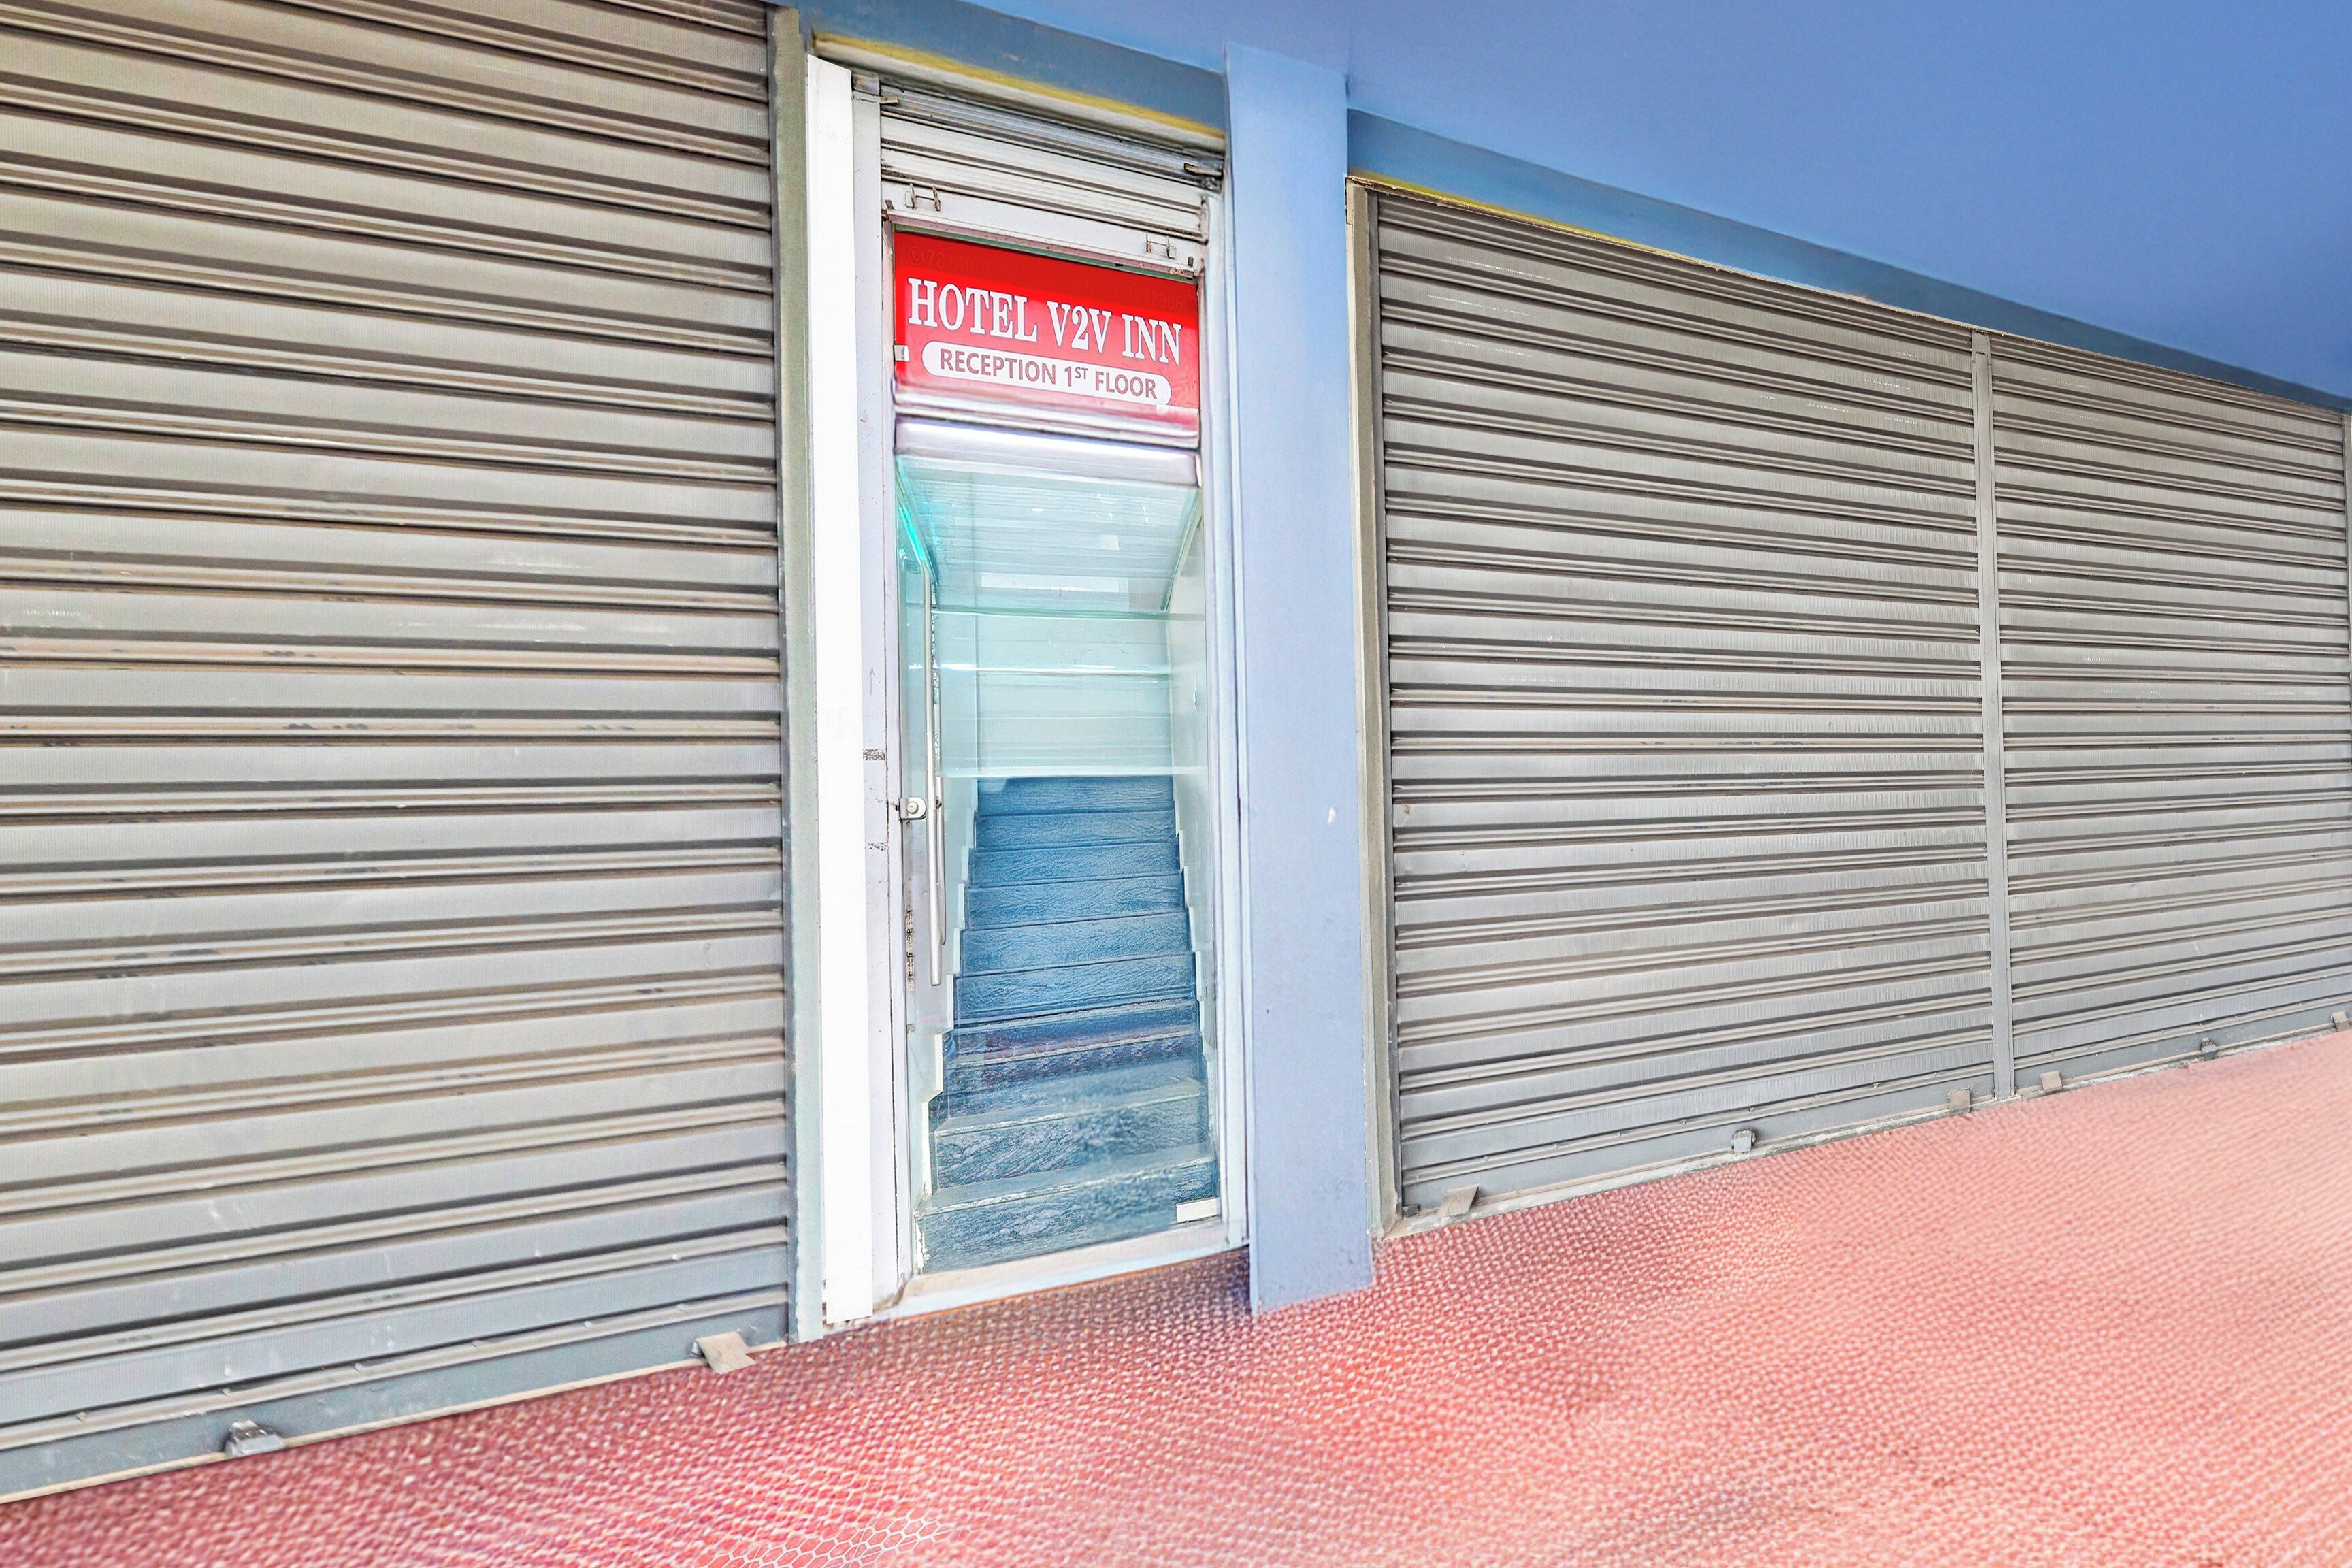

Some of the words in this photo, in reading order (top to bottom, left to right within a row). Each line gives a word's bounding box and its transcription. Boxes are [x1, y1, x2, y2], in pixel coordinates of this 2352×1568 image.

[908, 278, 1037, 342] HOTEL
[1047, 301, 1111, 353] V2V
[1122, 314, 1182, 365] INN
[941, 348, 1056, 385] RECEPTION
[1064, 366, 1088, 387] 1ST
[1095, 371, 1157, 399] FLOOR
